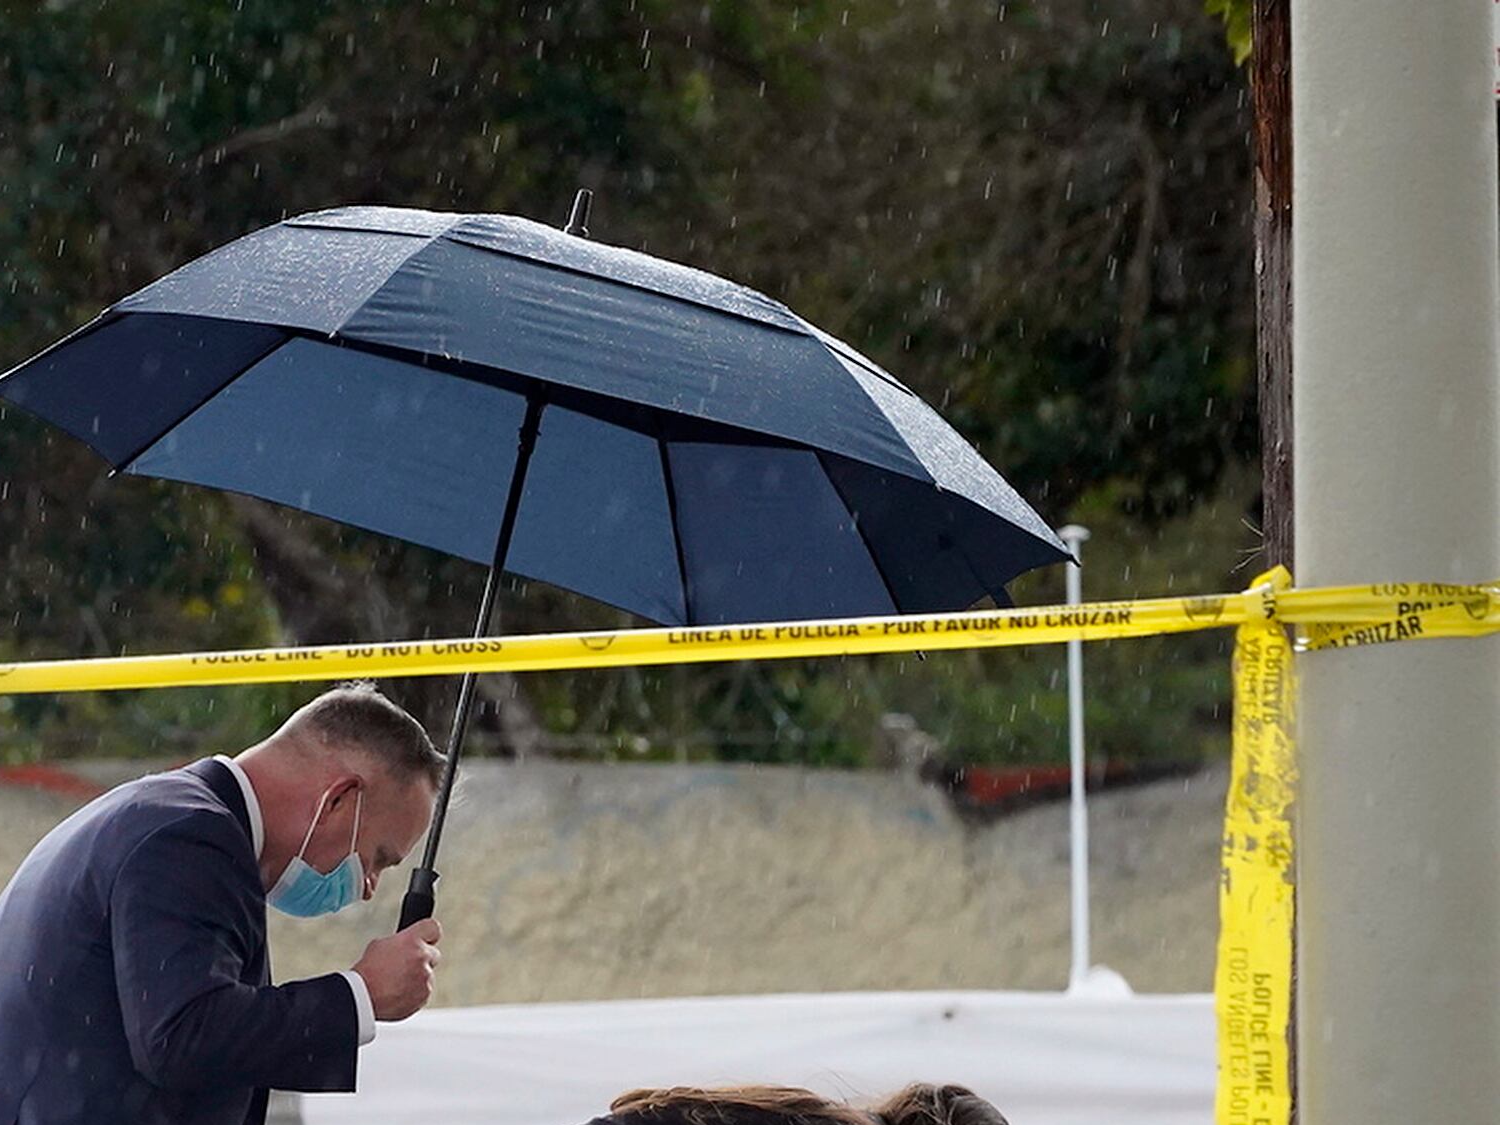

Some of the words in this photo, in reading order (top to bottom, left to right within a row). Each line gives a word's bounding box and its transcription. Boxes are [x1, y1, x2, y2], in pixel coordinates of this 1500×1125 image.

[775, 623, 860, 640] POLICIA
[883, 619, 927, 635] POR
[933, 616, 1001, 633] FAVOR
[1008, 613, 1039, 629] NO
[1044, 610, 1132, 627] CRUZAR
[1342, 616, 1424, 648] CRUZAR
[431, 639, 503, 655] CROSS
